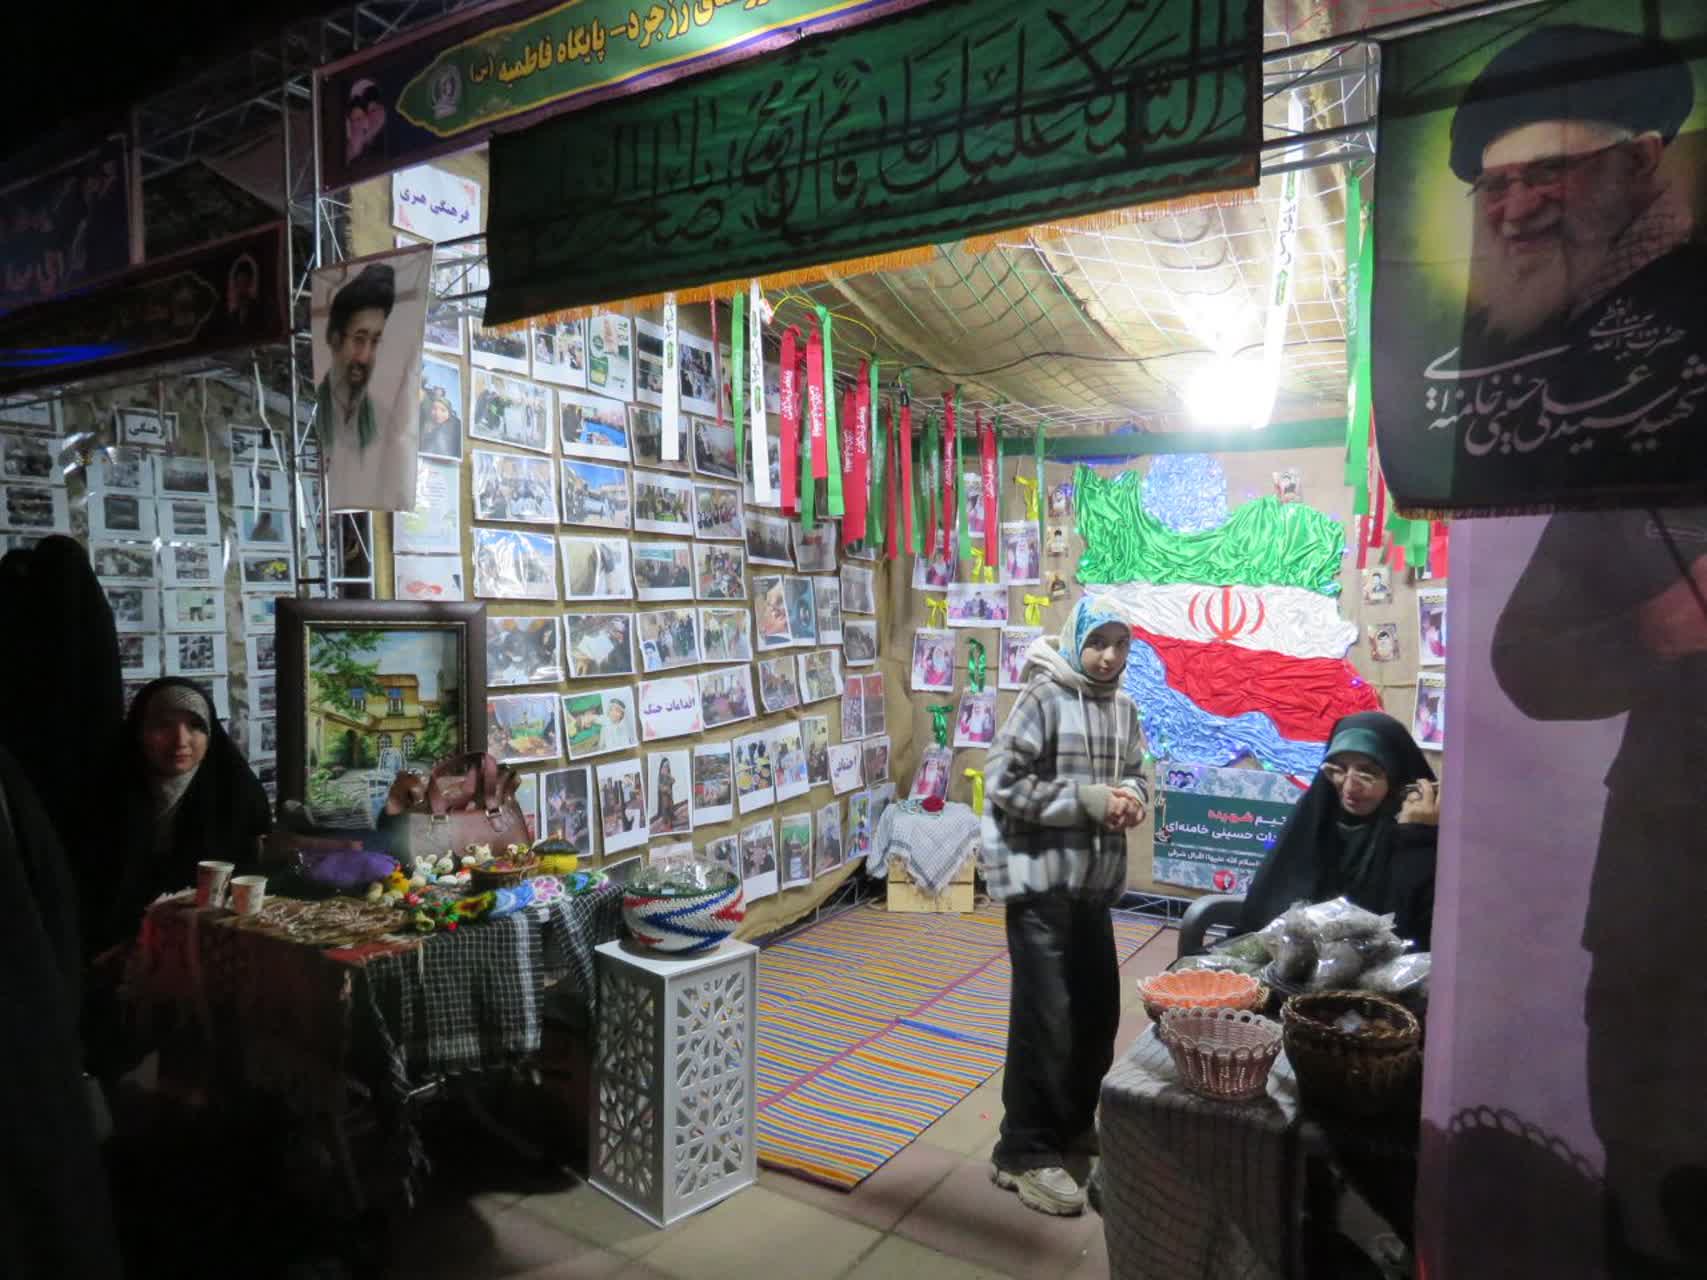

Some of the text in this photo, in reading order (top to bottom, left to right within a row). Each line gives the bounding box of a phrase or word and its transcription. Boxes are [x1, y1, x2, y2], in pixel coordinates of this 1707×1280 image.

[557, 18, 606, 64] پایگاه
[498, 34, 553, 88] فاطمیه
[430, 199, 471, 223] فرهنگی
[1211, 826, 1253, 840] حسینی
